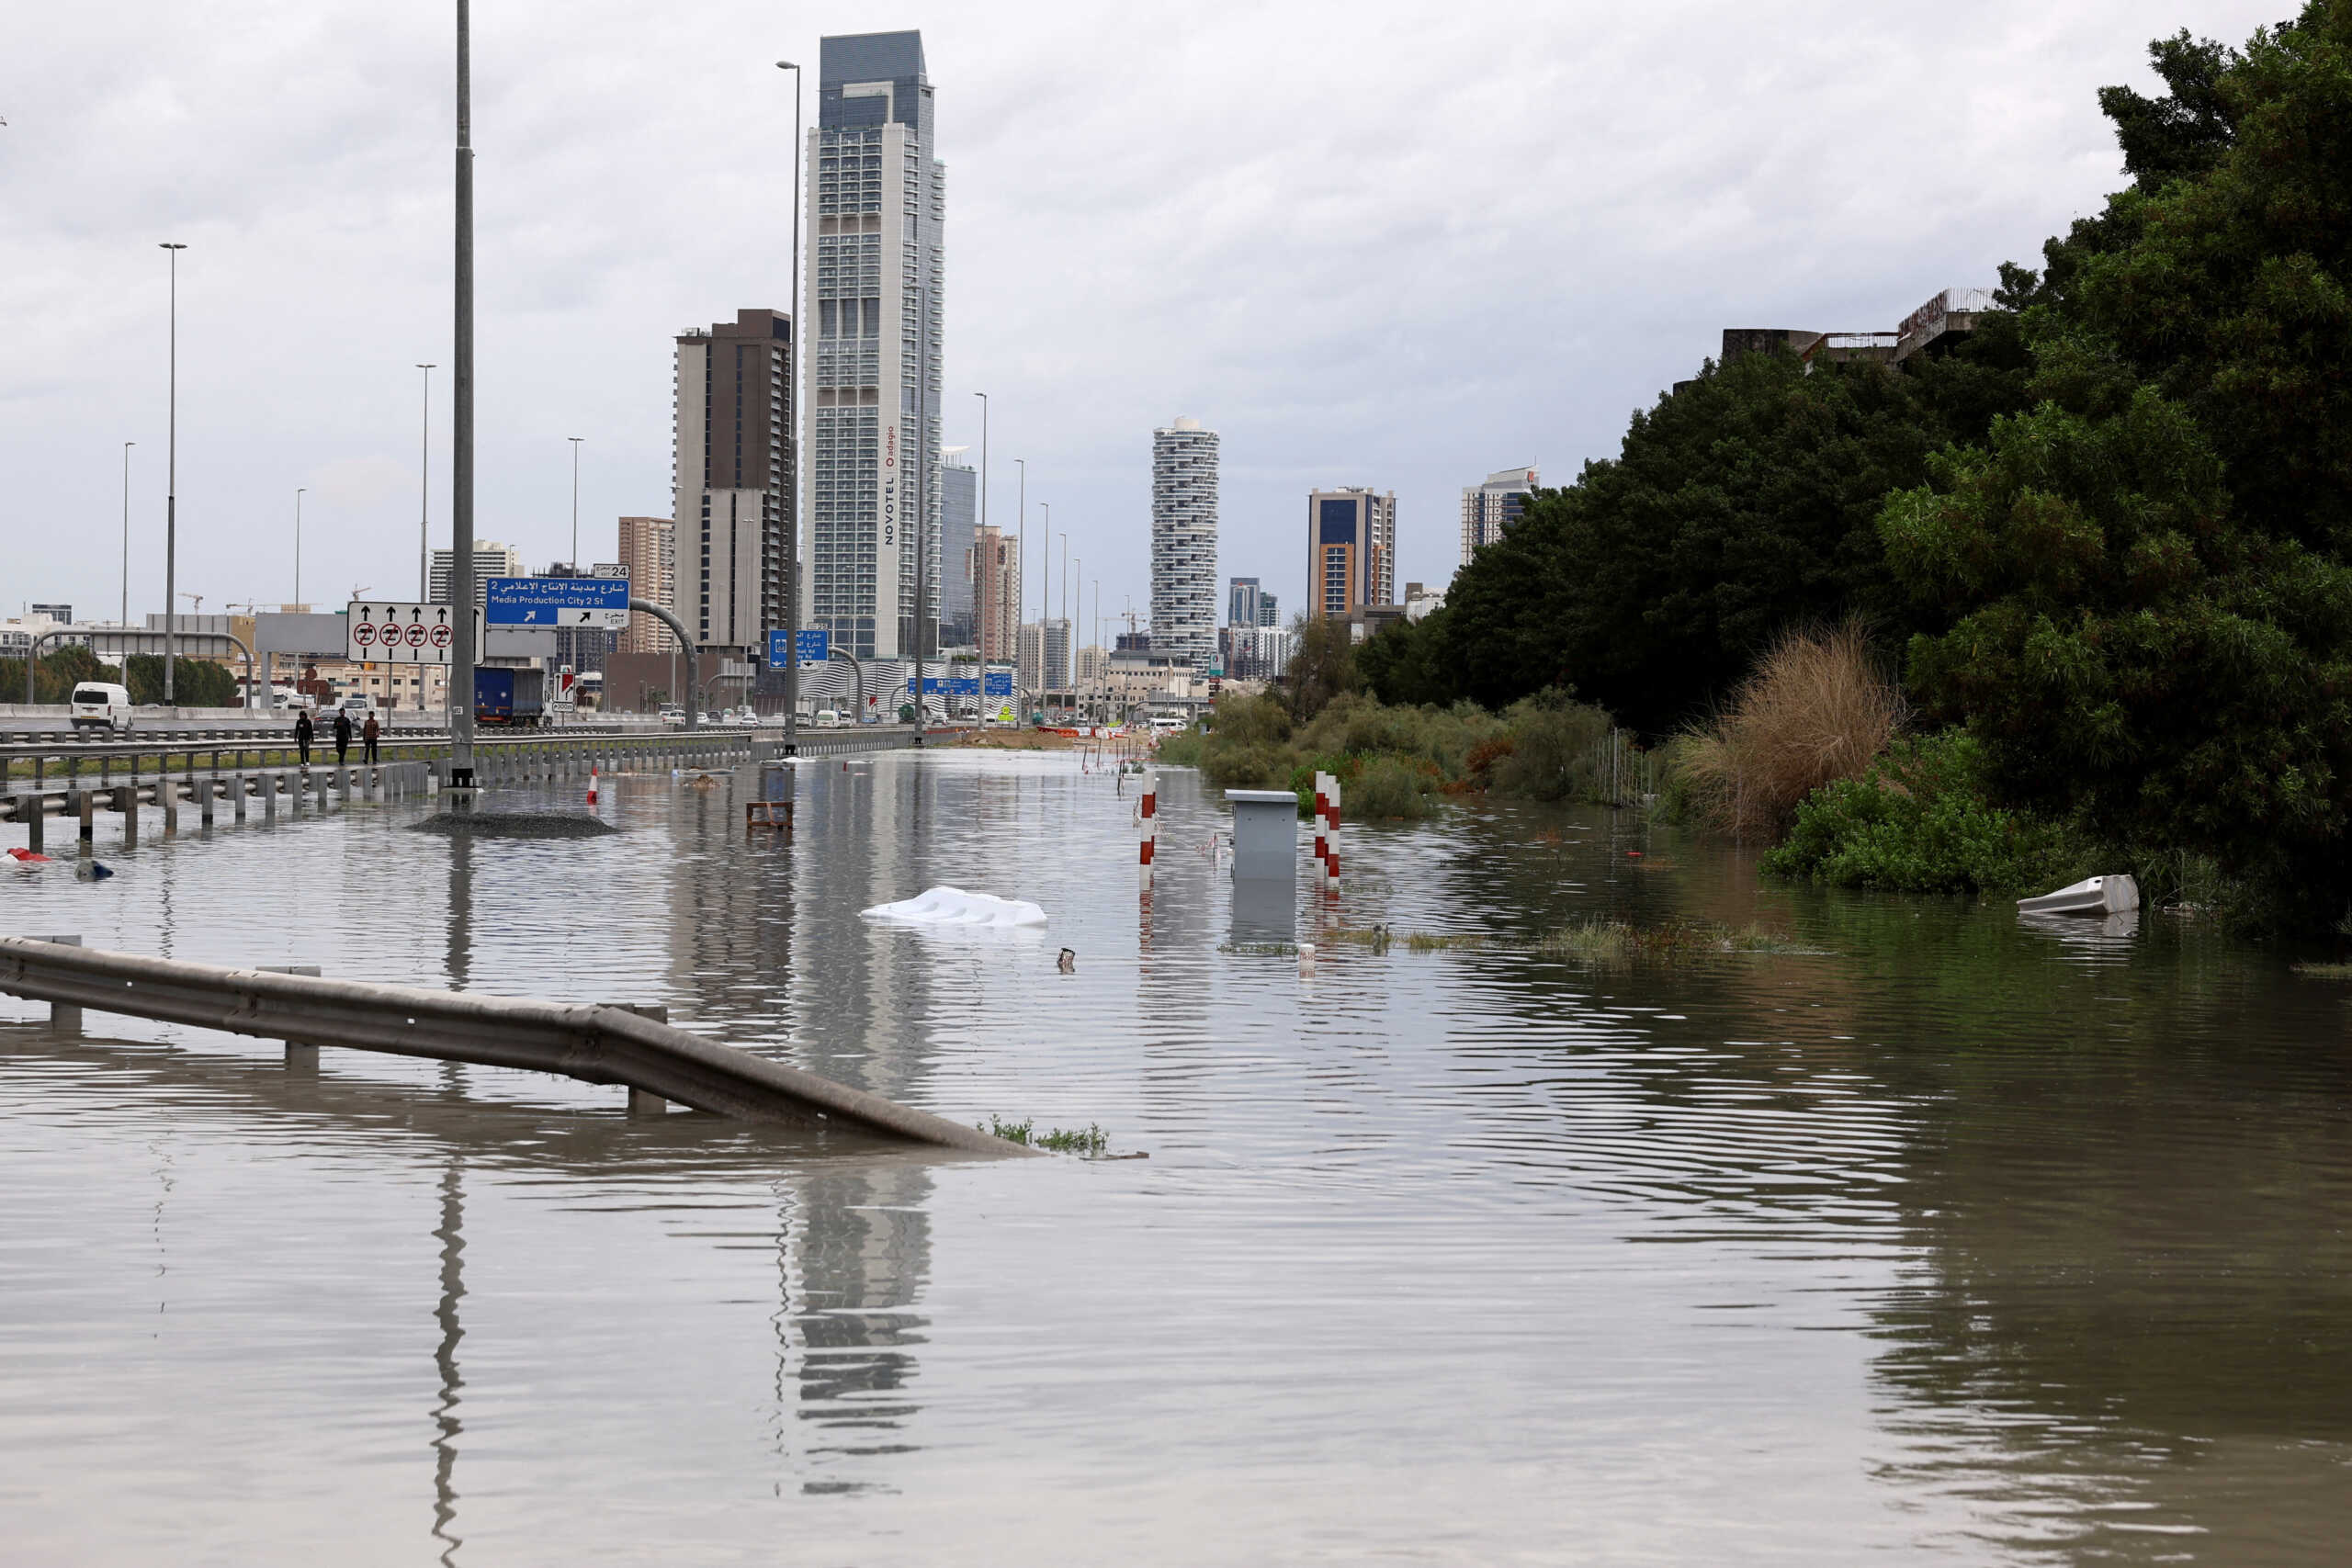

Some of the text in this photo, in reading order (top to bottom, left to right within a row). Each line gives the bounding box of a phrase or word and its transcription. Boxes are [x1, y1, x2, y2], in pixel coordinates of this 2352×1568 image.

[885, 426, 895, 545] NOVOTEL adagio
[612, 566, 627, 577] 24
[491, 581, 625, 594] شارع مدينة الإنتاج الإعلامي 2
[491, 595, 517, 604] Media
[519, 596, 565, 605] Production
[567, 596, 583, 606] City
